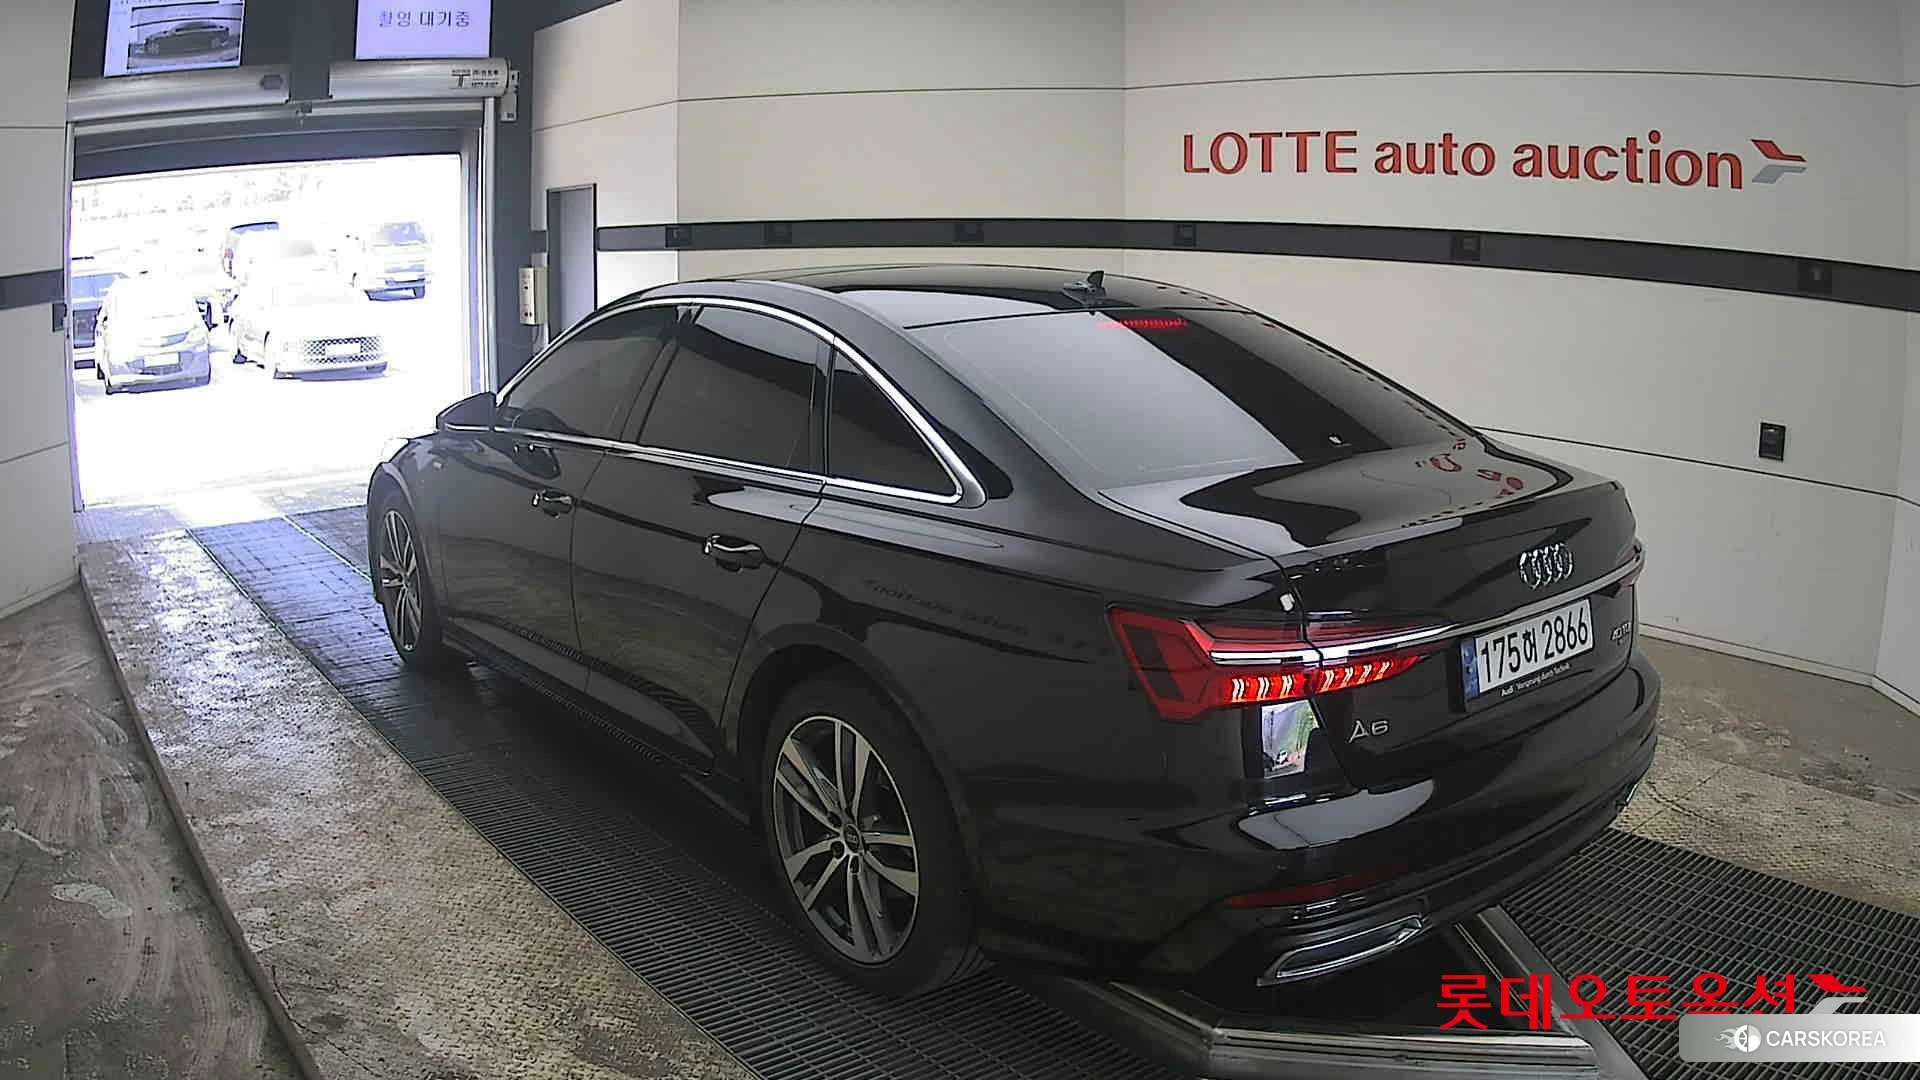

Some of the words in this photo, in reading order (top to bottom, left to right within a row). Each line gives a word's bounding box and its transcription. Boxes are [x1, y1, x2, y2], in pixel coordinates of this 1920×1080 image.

[1183, 130, 1358, 174] LOTTE
[1374, 132, 1496, 177] auto
[1512, 129, 1743, 190] auction
[1481, 628, 1538, 684] 175허
[1541, 607, 1588, 661] 2866
[1349, 720, 1389, 743] A6
